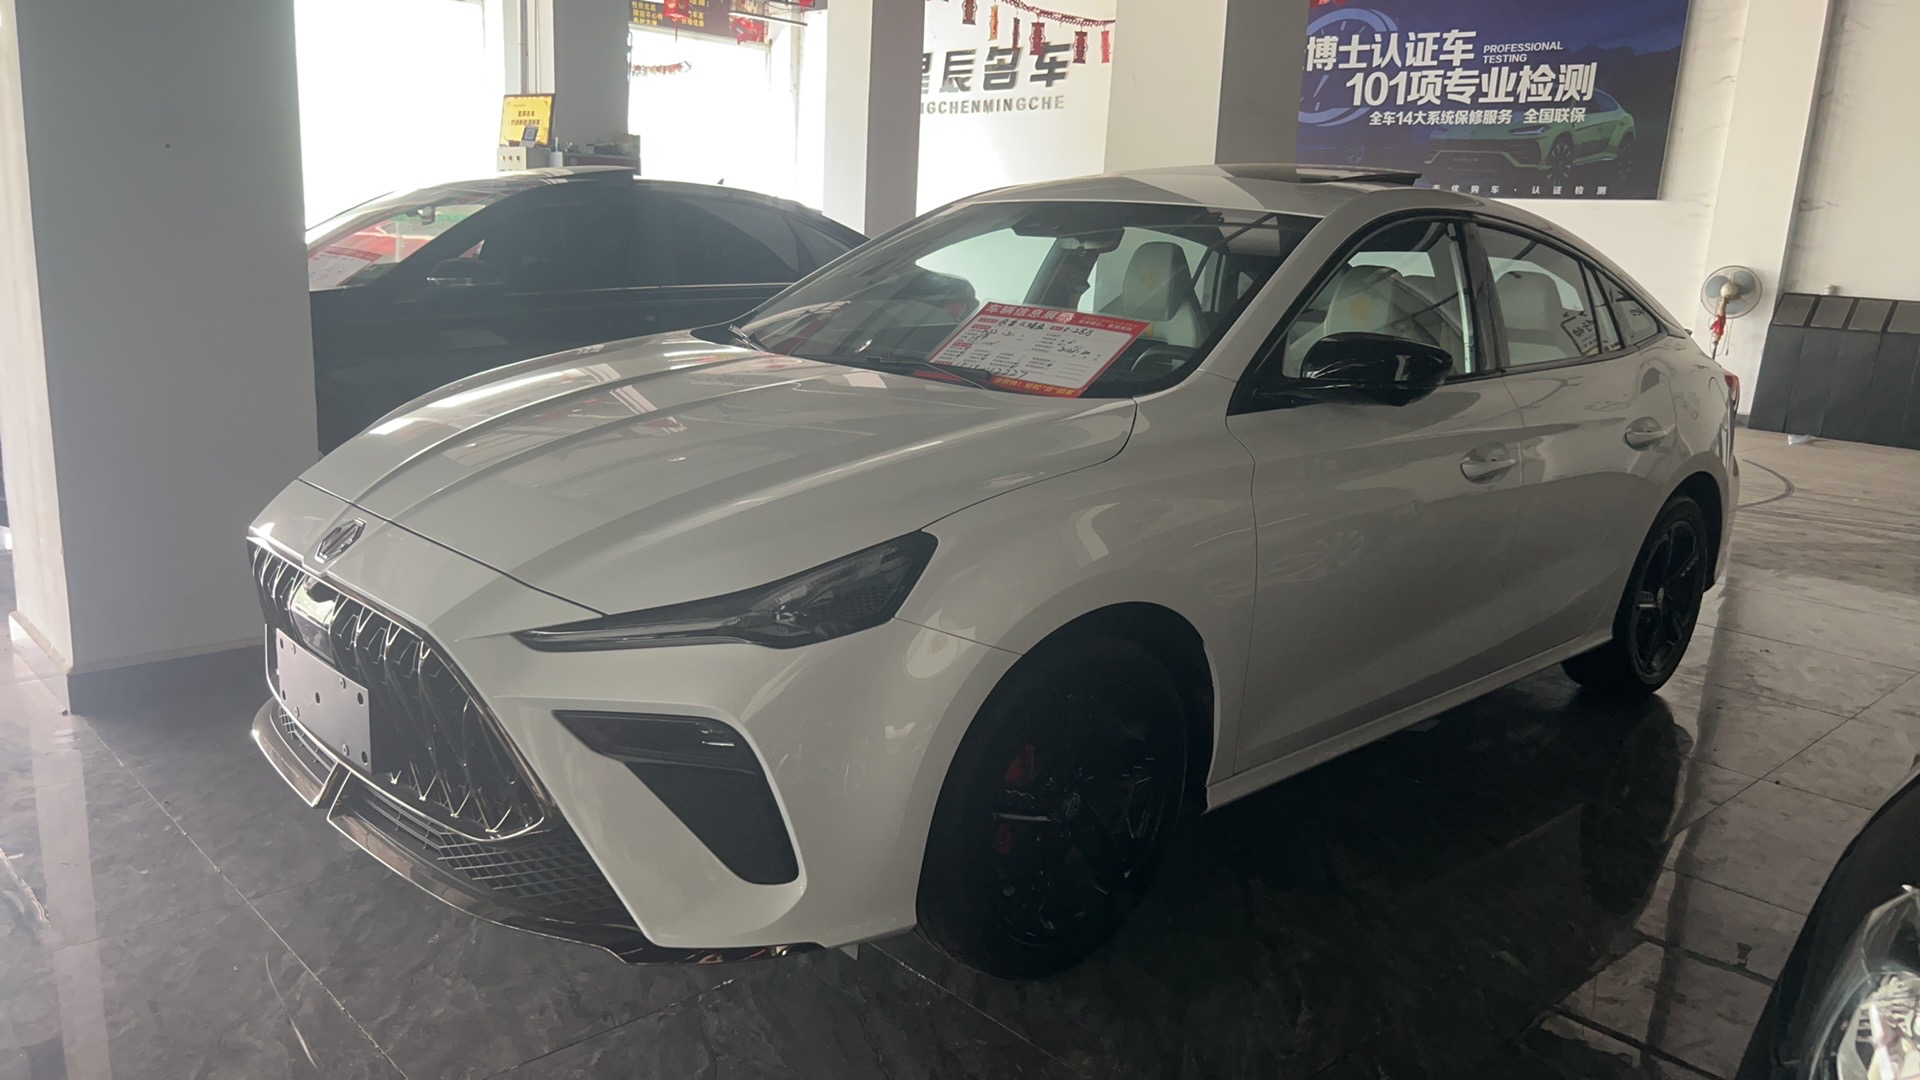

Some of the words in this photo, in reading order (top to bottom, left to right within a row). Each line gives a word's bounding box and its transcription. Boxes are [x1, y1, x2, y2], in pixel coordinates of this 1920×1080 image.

[1306, 29, 1477, 71] 博士认证车
[1483, 41, 1563, 54] PROFESSIONAL
[1482, 53, 1528, 64] TESTING
[1345, 62, 1598, 107] 101项专业检测
[1368, 109, 1513, 127] 全车14大系统保修服务
[1523, 107, 1586, 125] 全国联保
[985, 304, 1076, 324] 车辆信息展示
